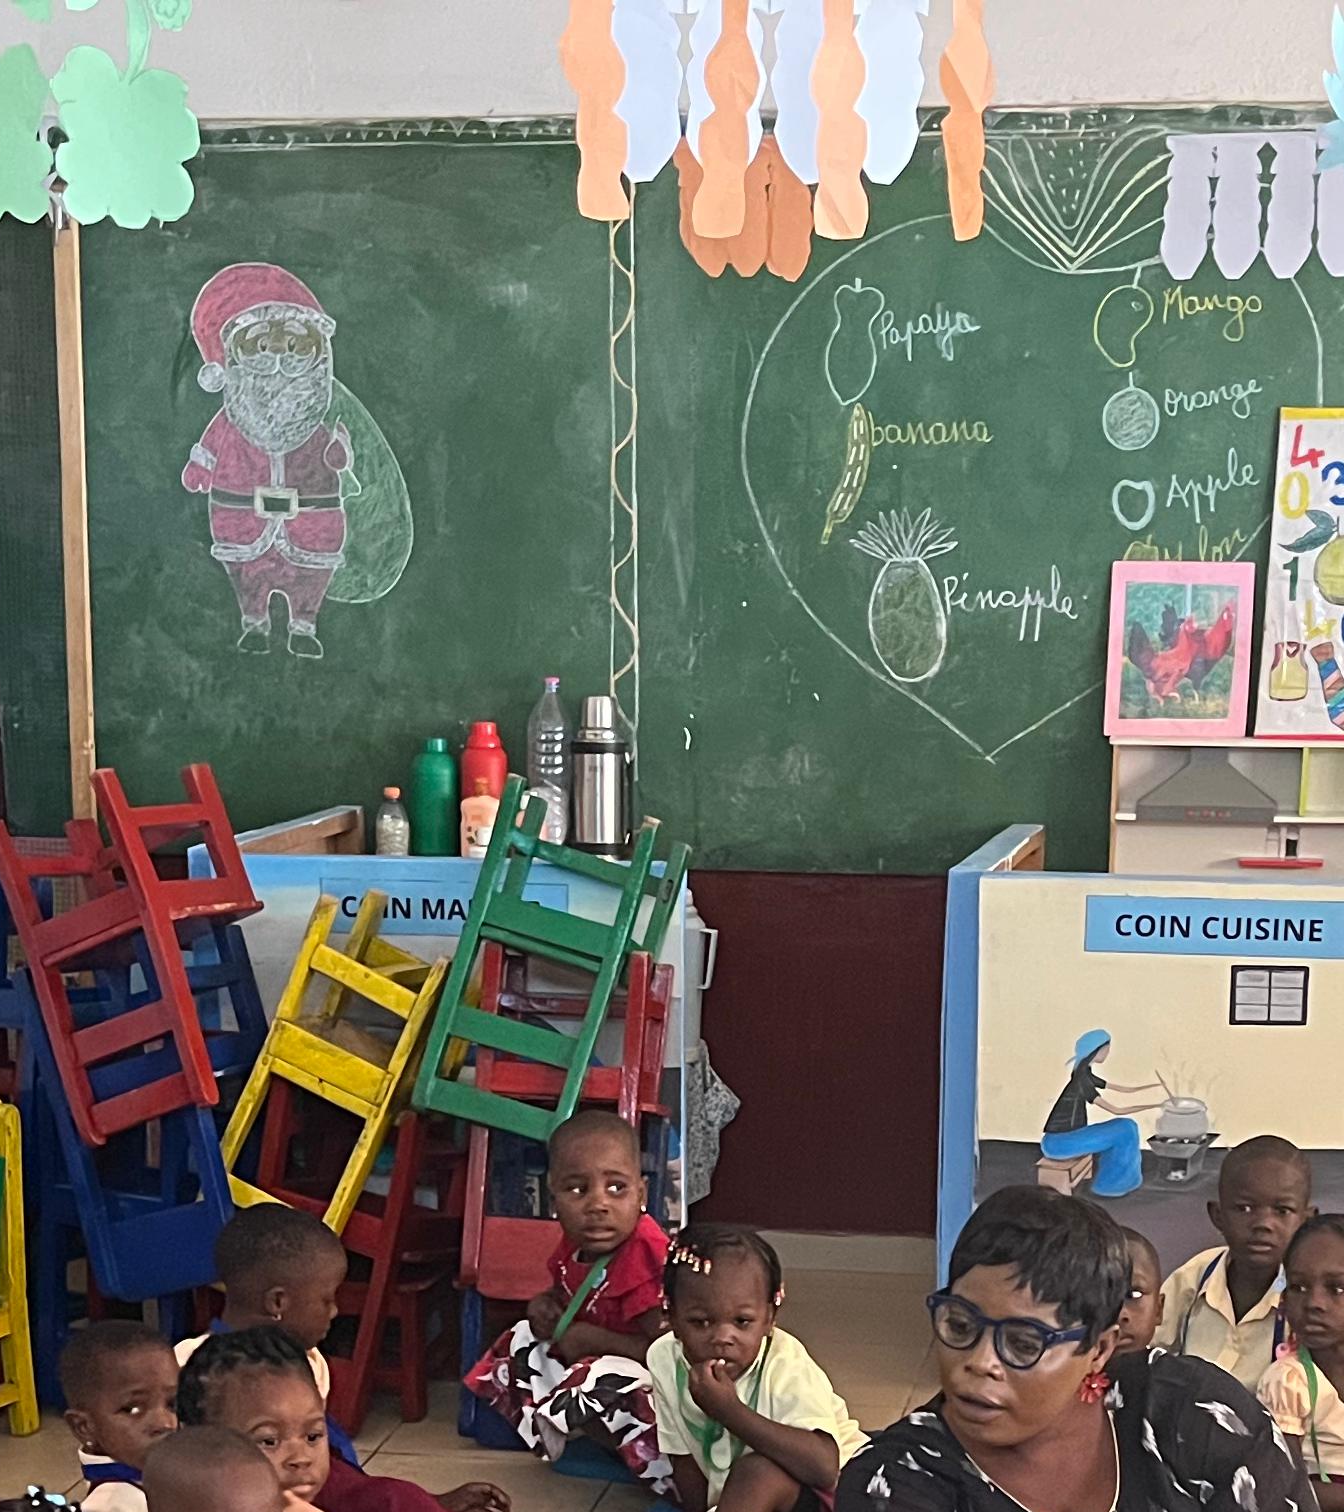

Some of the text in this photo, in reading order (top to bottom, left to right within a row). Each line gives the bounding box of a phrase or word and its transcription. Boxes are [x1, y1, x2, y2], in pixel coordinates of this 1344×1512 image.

[879, 306, 981, 362] Papaya
[1163, 285, 1263, 342] Mango
[868, 411, 994, 447] banana
[1289, 424, 1326, 468] 4
[1166, 447, 1260, 524] Apple
[1278, 471, 1310, 520] 0
[1282, 556, 1300, 602] 1
[943, 564, 1079, 642] Pinapple
[341, 895, 412, 919] CIN
[1114, 913, 1325, 942] COIN CUISINE
